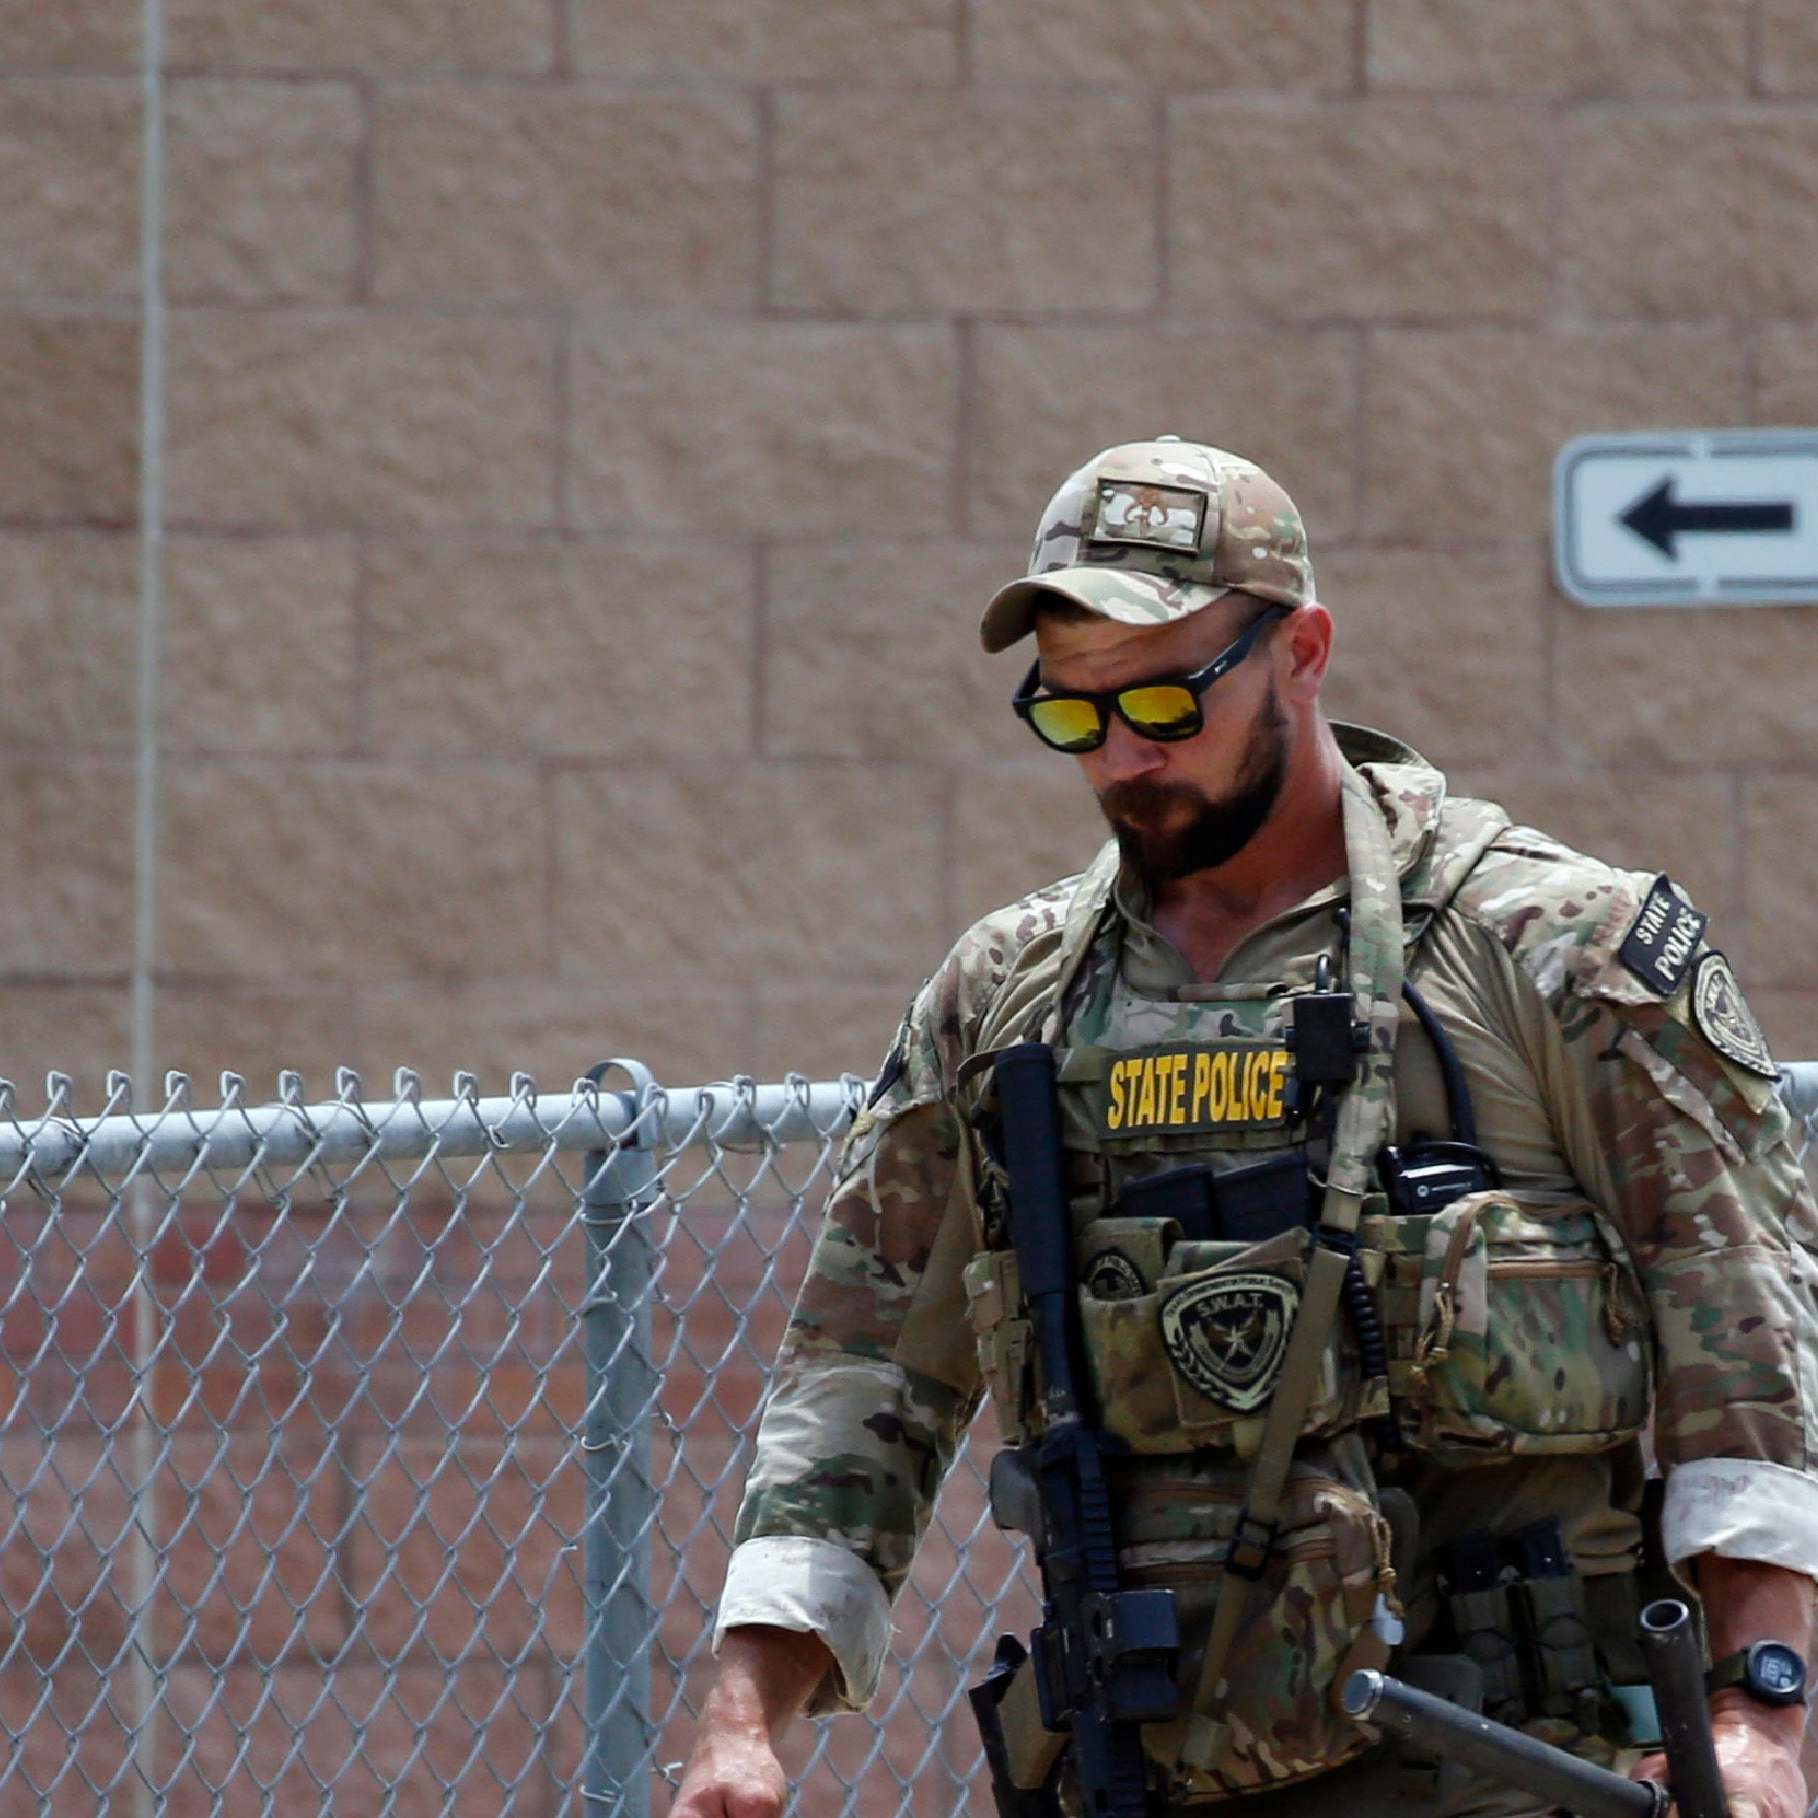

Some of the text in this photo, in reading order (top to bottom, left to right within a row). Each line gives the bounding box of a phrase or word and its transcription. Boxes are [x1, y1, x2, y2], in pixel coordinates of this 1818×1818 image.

[1636, 891, 1670, 945] STATE
[1654, 907, 1701, 981] POLICE
[1108, 1051, 1289, 1130] STATE POLICE
